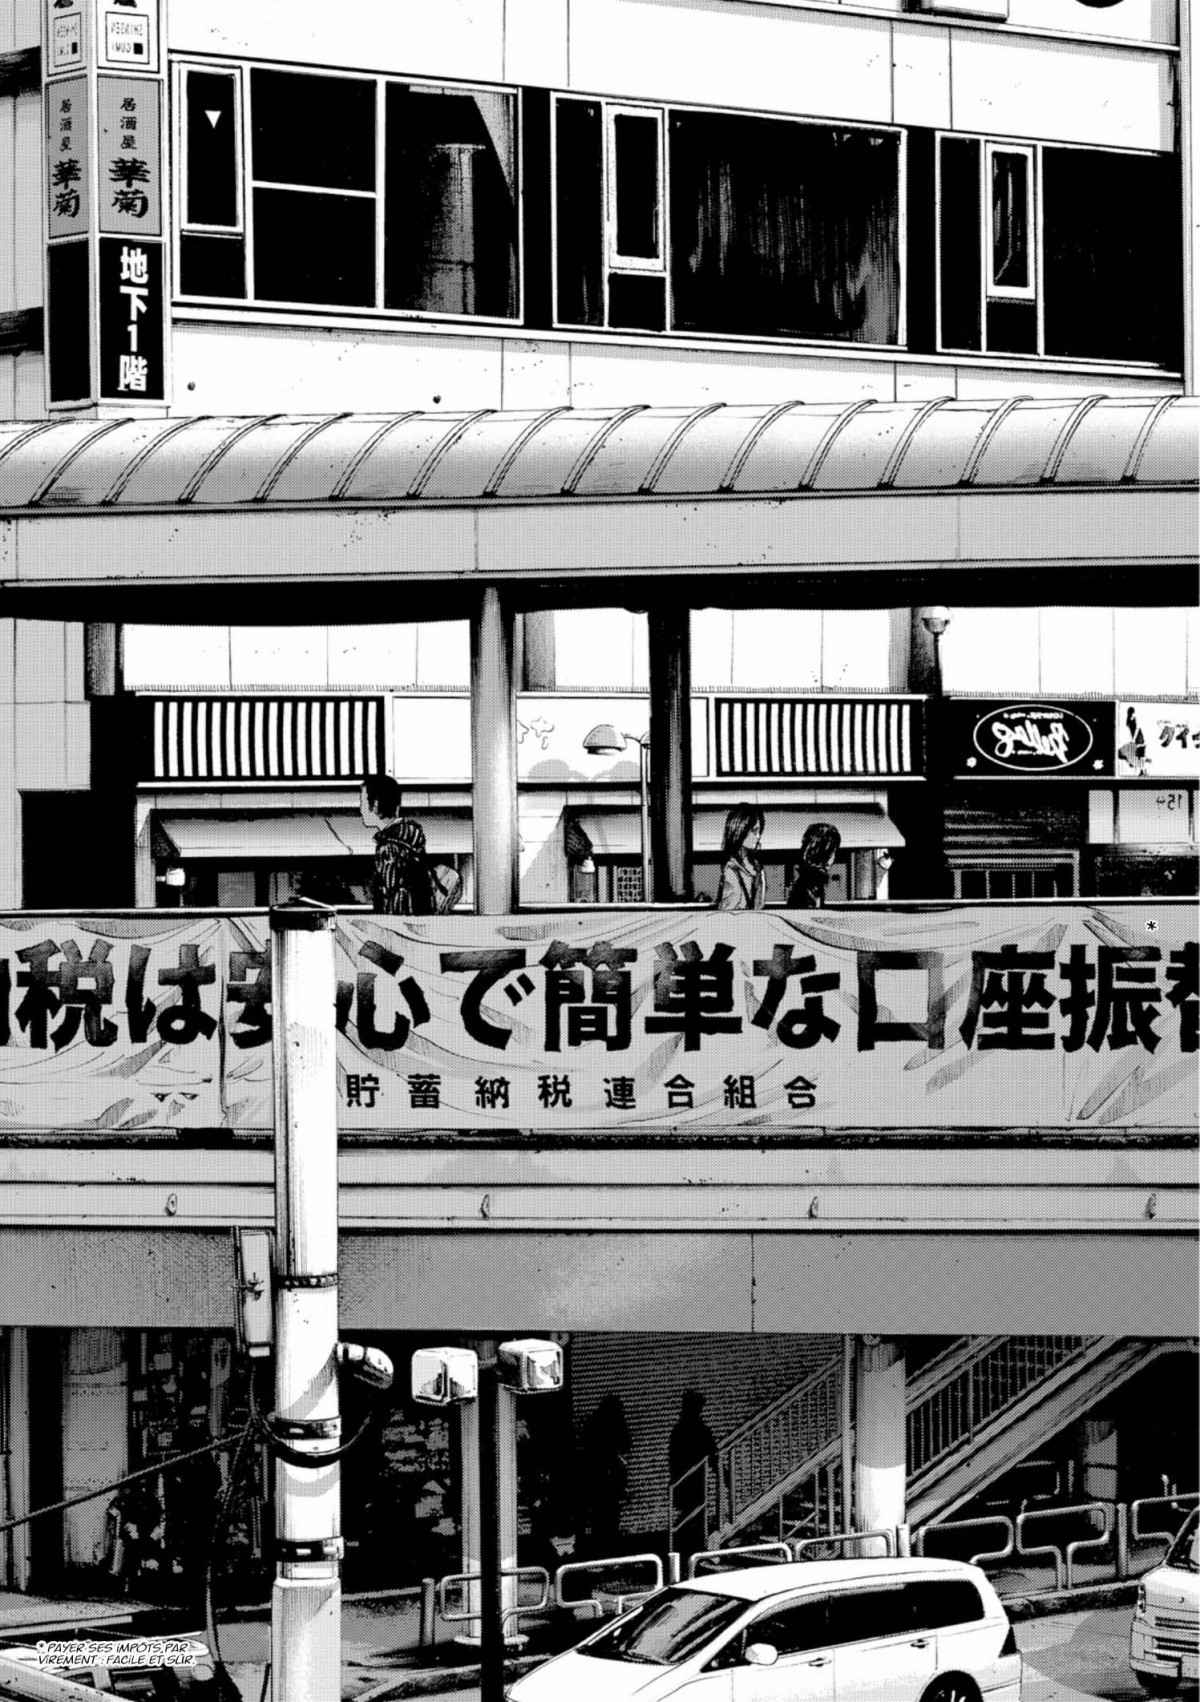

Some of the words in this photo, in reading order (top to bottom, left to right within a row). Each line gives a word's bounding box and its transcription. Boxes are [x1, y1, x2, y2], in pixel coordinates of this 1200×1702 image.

[108, 157, 151, 219] 華菊
[117, 246, 149, 392] 地下1階
